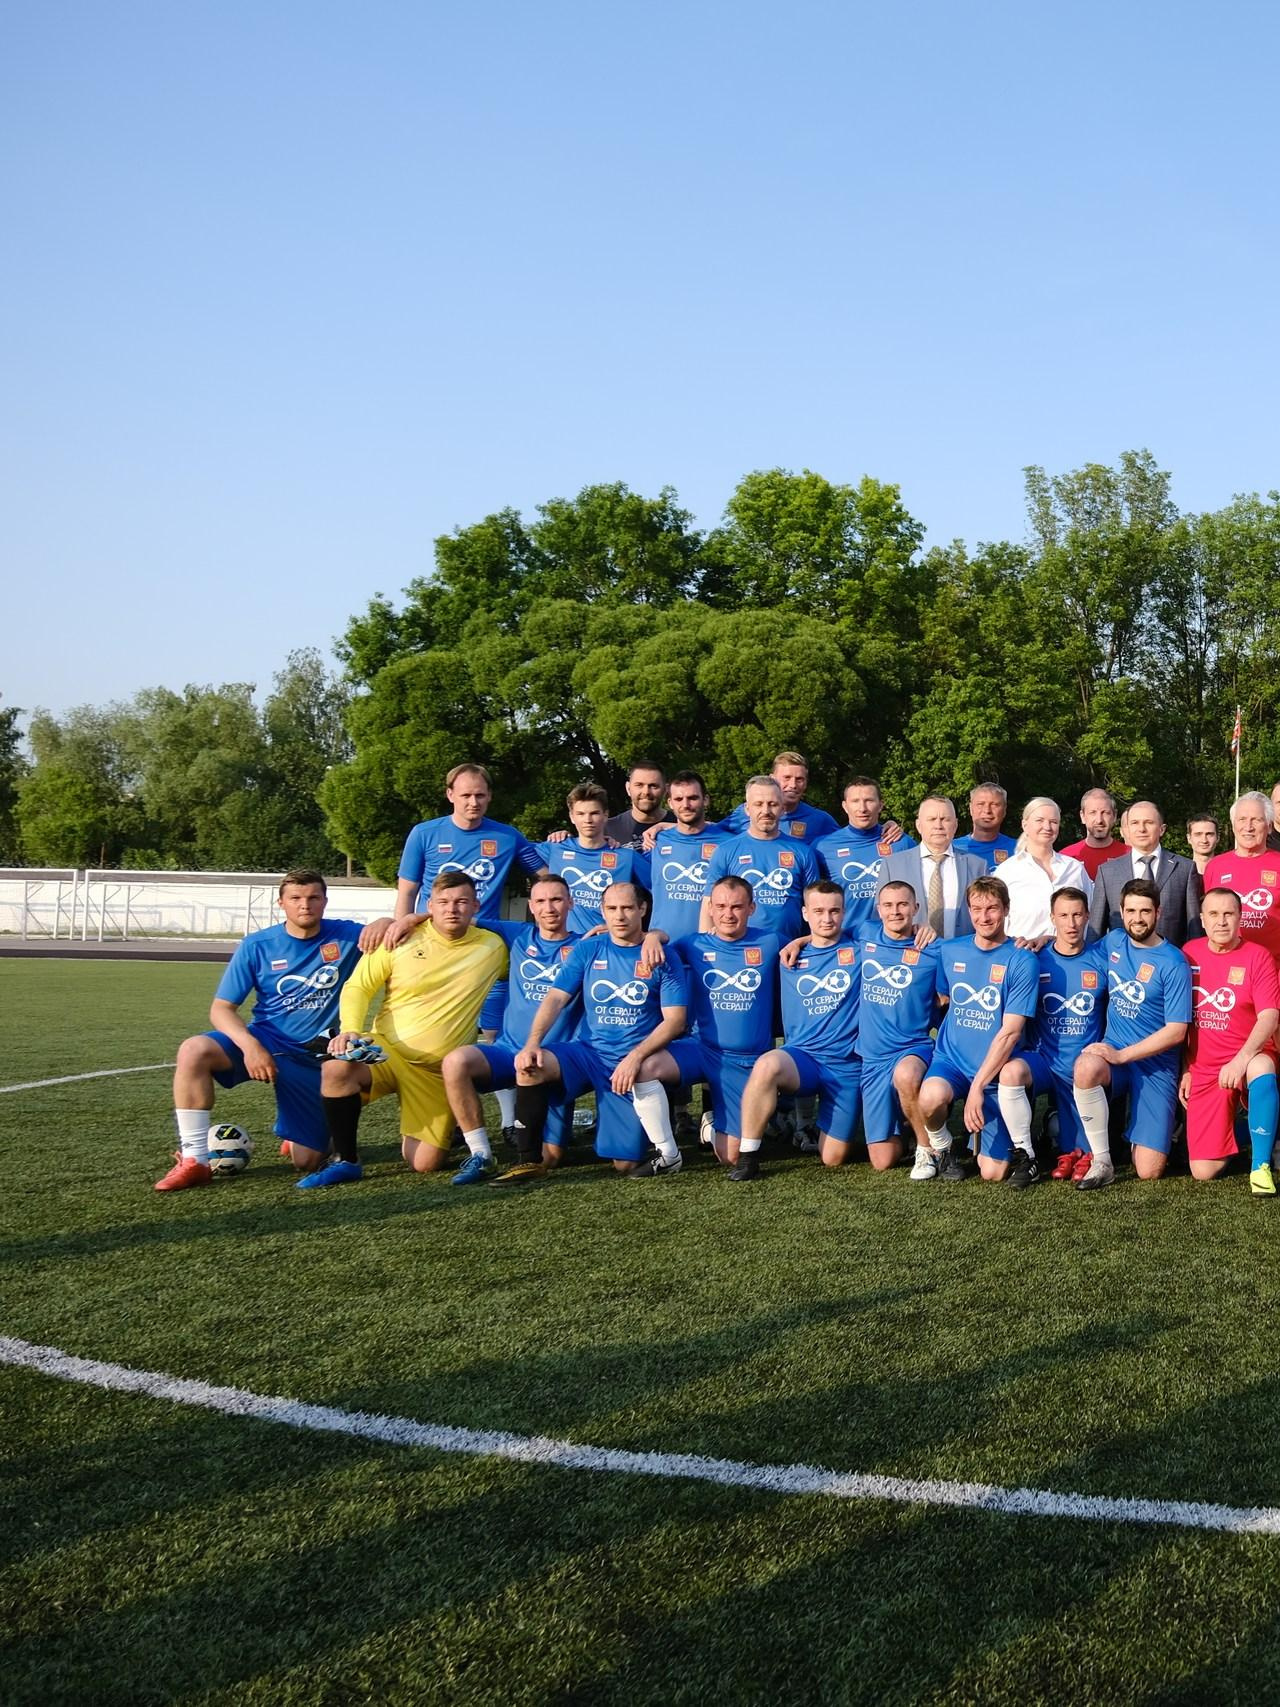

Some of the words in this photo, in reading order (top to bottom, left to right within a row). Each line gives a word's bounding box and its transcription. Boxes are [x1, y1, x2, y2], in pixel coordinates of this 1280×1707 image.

[1241, 911, 1268, 919] ЕРДЦА
[1239, 920, 1265, 928] ЕРДЦУ
[872, 985, 902, 998] СЕРДЦА
[710, 992, 720, 1000] ОТ
[723, 993, 756, 1001] СЕРДЦА
[803, 998, 814, 1006] ОТ
[816, 993, 846, 1004] СЕРДЦА
[868, 994, 897, 1006] СЕРДЦУ
[721, 1002, 752, 1010] СЕРДЦУ
[596, 1006, 606, 1014] ОТ
[609, 1007, 642, 1016] СЕРДЦА
[809, 1008, 814, 1016] К
[966, 1008, 995, 1021] СЕРДЦА
[599, 1016, 604, 1024] К
[605, 1017, 638, 1025] СЕРДЦУ
[1201, 1011, 1230, 1021] СЕРДЦА
[957, 1018, 962, 1026] К
[963, 1019, 991, 1032] СЕРДЦУ
[1059, 1017, 1090, 1025] СЕРДЦА
[1200, 1021, 1228, 1030] СЕРДЦУ
[1057, 1026, 1087, 1035] СЕРДЦУ
